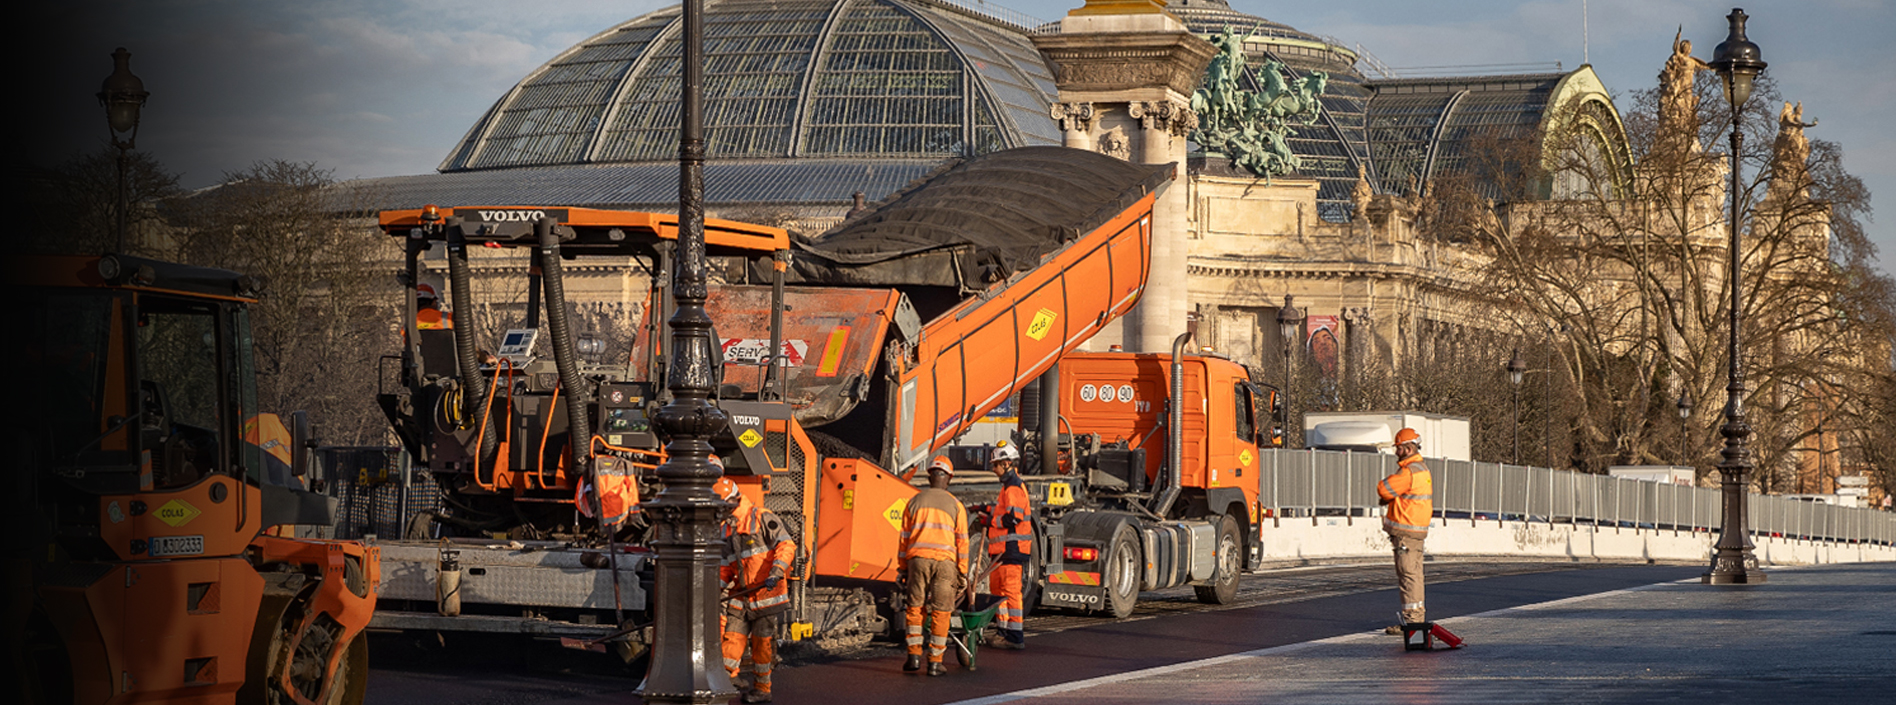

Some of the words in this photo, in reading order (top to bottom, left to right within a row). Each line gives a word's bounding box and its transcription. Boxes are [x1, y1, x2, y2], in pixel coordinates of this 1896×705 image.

[478, 210, 546, 222] VOLVO
[1083, 386, 1095, 400] 60
[1101, 386, 1113, 400] 80
[1120, 386, 1132, 401] 90
[732, 415, 760, 426] VOLVO
[161, 508, 184, 518] COLAS
[889, 509, 903, 521] COL
[1048, 591, 1098, 604] VOLVO
